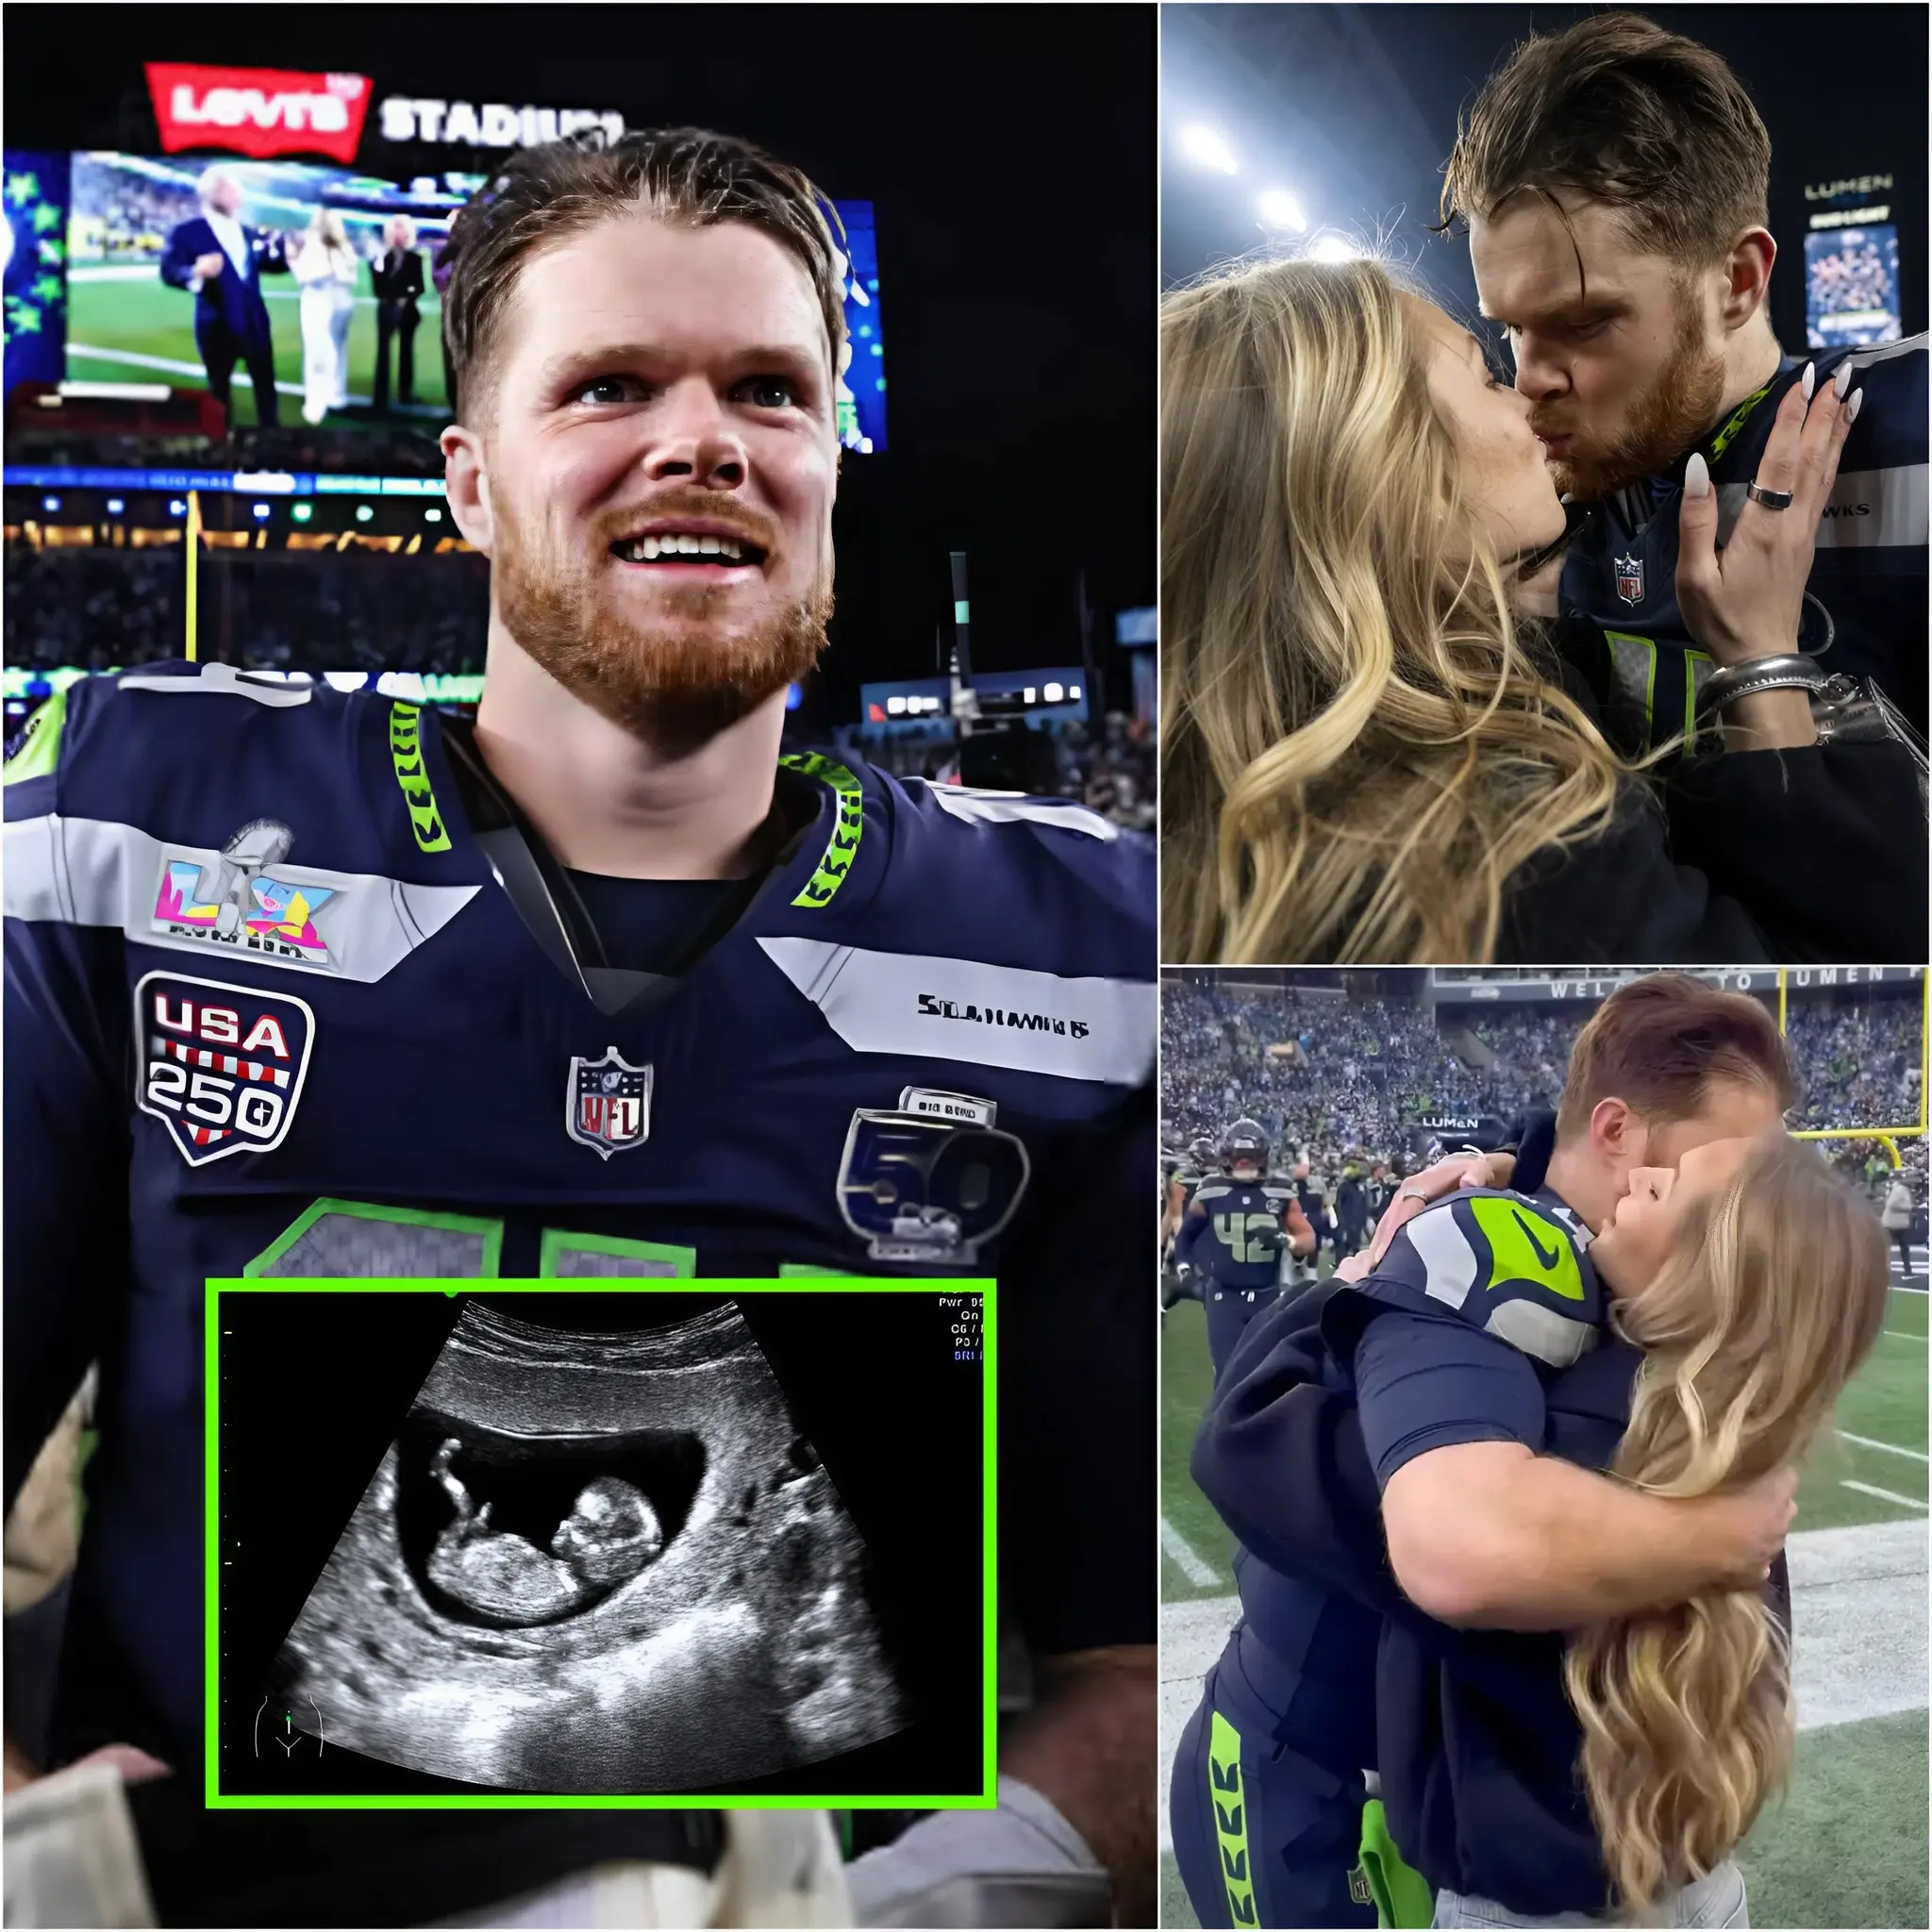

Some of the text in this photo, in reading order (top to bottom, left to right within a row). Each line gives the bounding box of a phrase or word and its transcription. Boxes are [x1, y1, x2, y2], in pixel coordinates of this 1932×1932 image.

[1805, 173, 1893, 200] LUMEN
[155, 993, 290, 1058] USA
[147, 1061, 284, 1139] 250
[1213, 1212, 1279, 1263] 42
